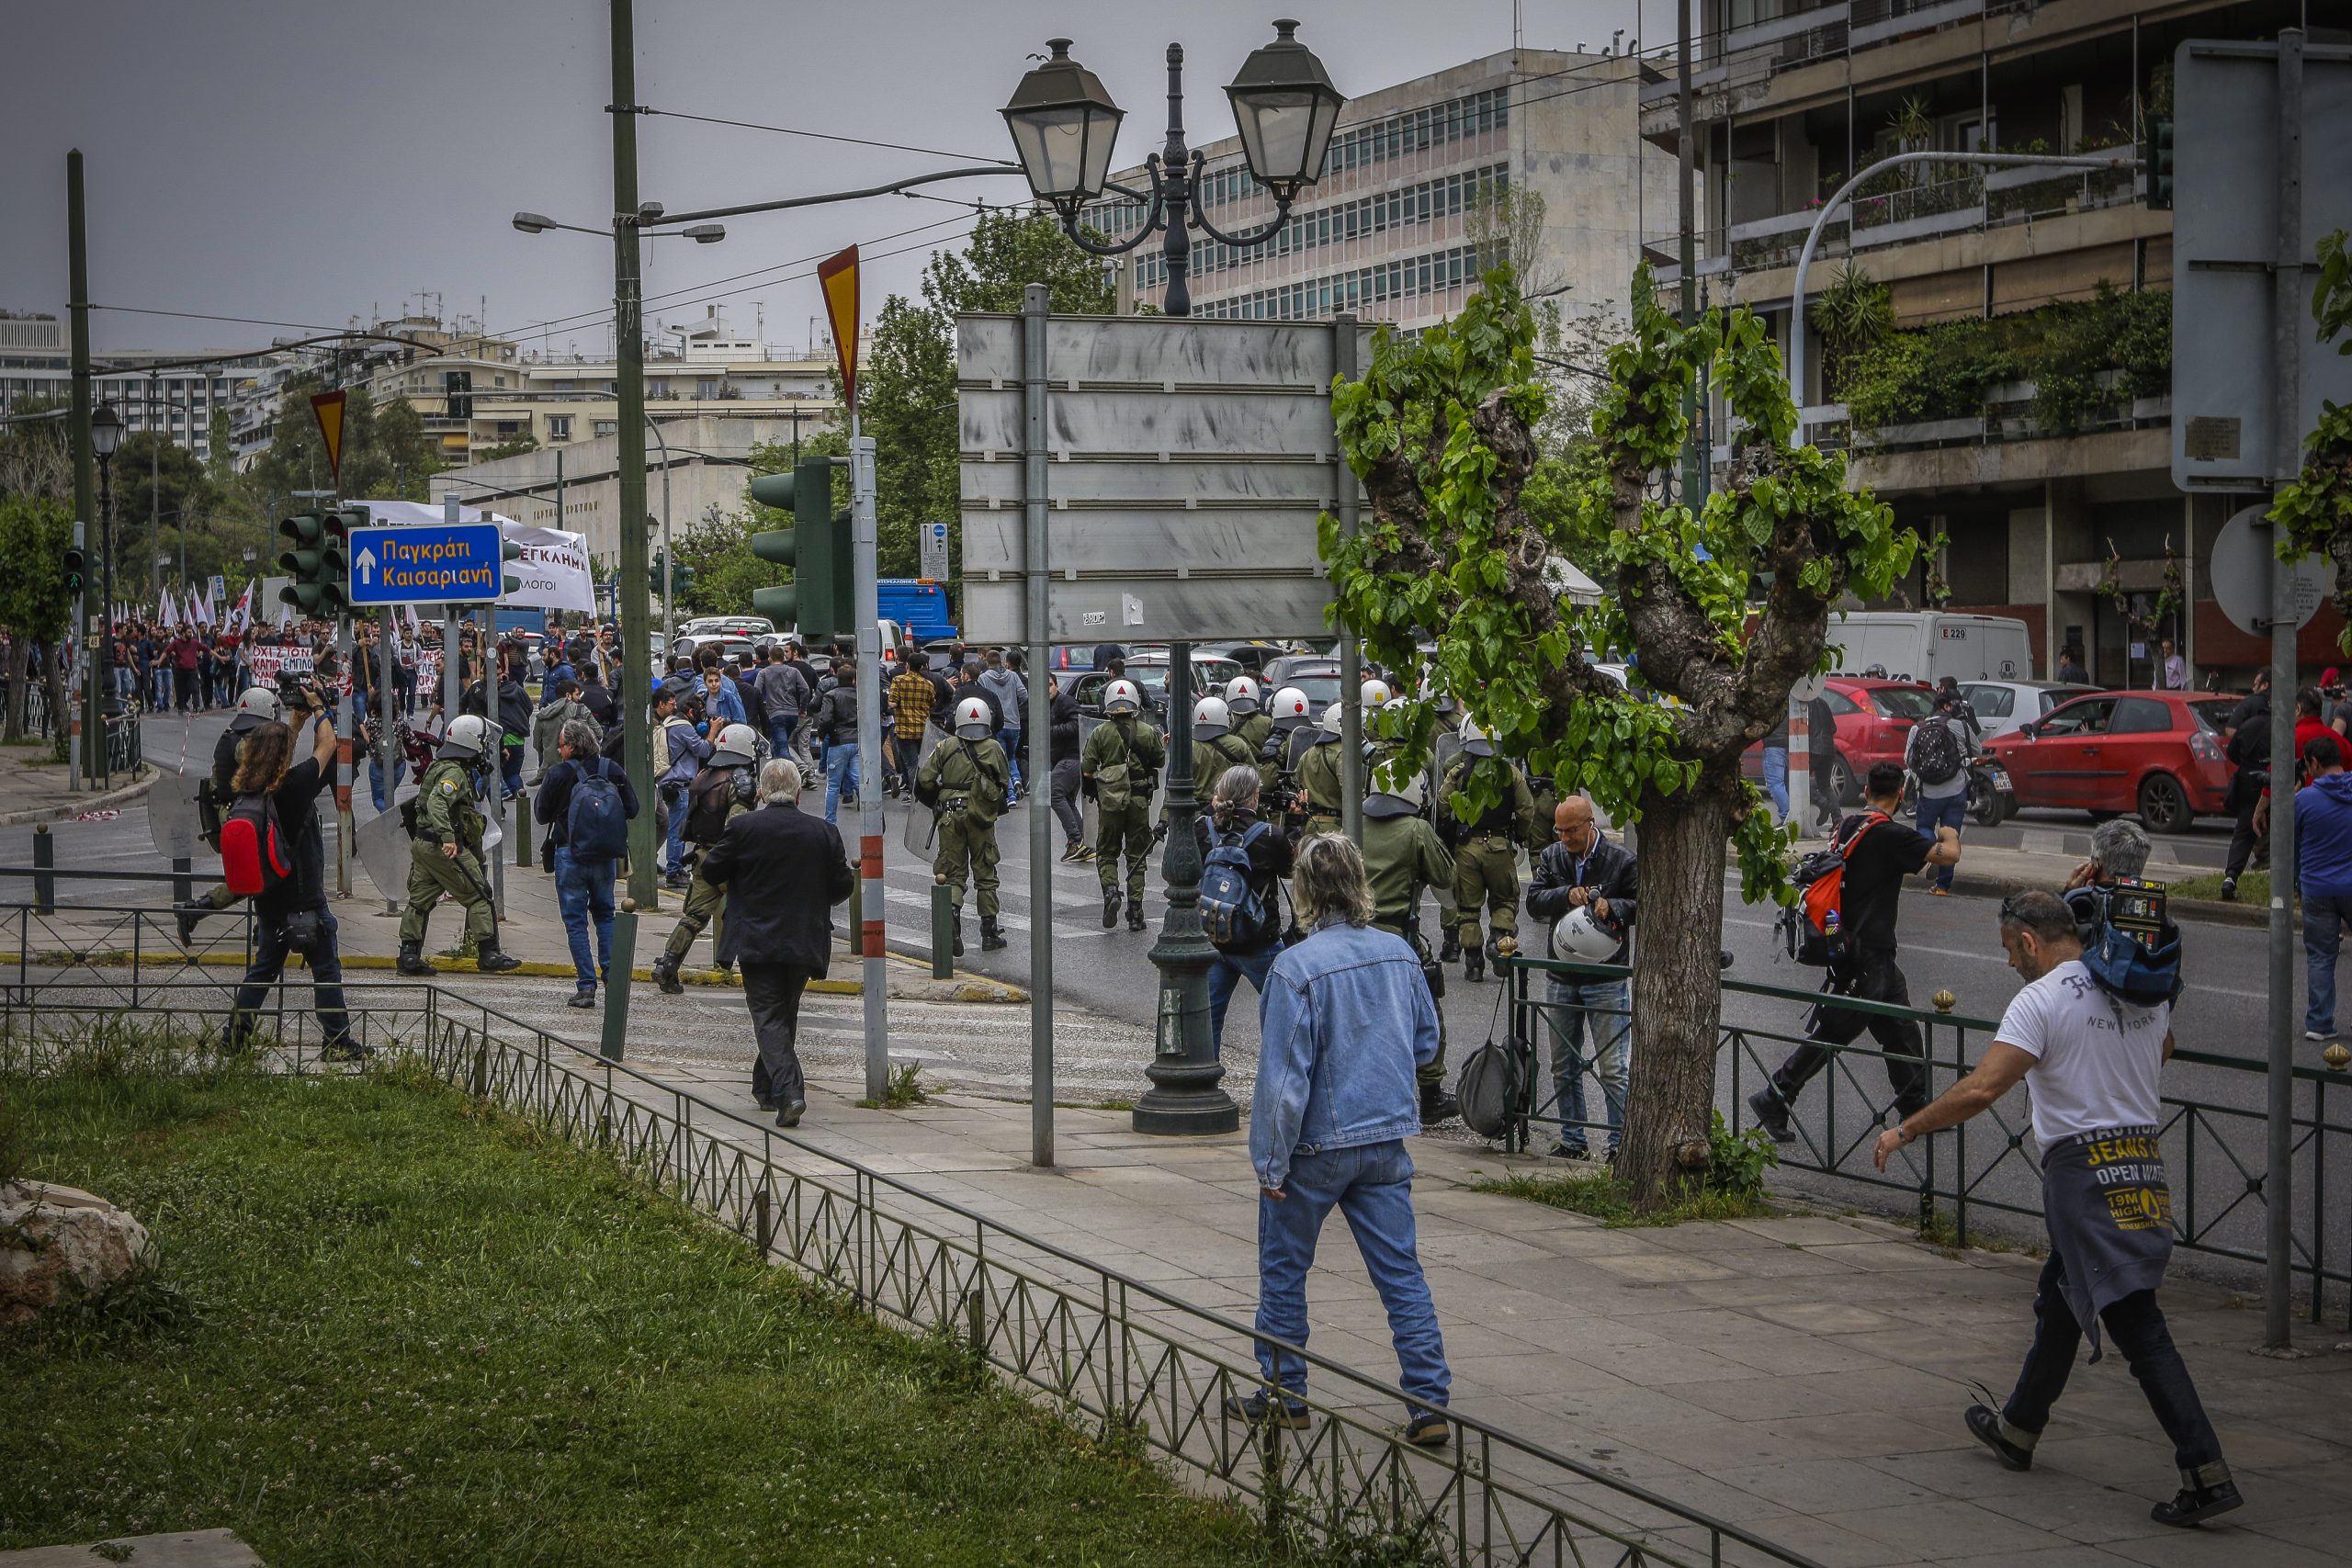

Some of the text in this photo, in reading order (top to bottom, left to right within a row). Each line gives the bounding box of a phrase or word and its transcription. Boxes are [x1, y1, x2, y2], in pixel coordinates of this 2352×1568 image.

[383, 536, 470, 564] Παγκράτι
[520, 548, 586, 571] ΕΓΚΛΗΜΑ
[383, 562, 492, 590] Καισαριανή
[1951, 628, 1965, 638] 229
[253, 646, 310, 658] ΟΧΙ ΣΤΟΝ
[2087, 1013, 2156, 1031] NEW YORK
[2087, 1137, 2149, 1165] JEANS
[2096, 1164, 2140, 1185] OPEN
[2108, 1193, 2138, 1208] 19M
[2110, 1205, 2143, 1218] HIGH
